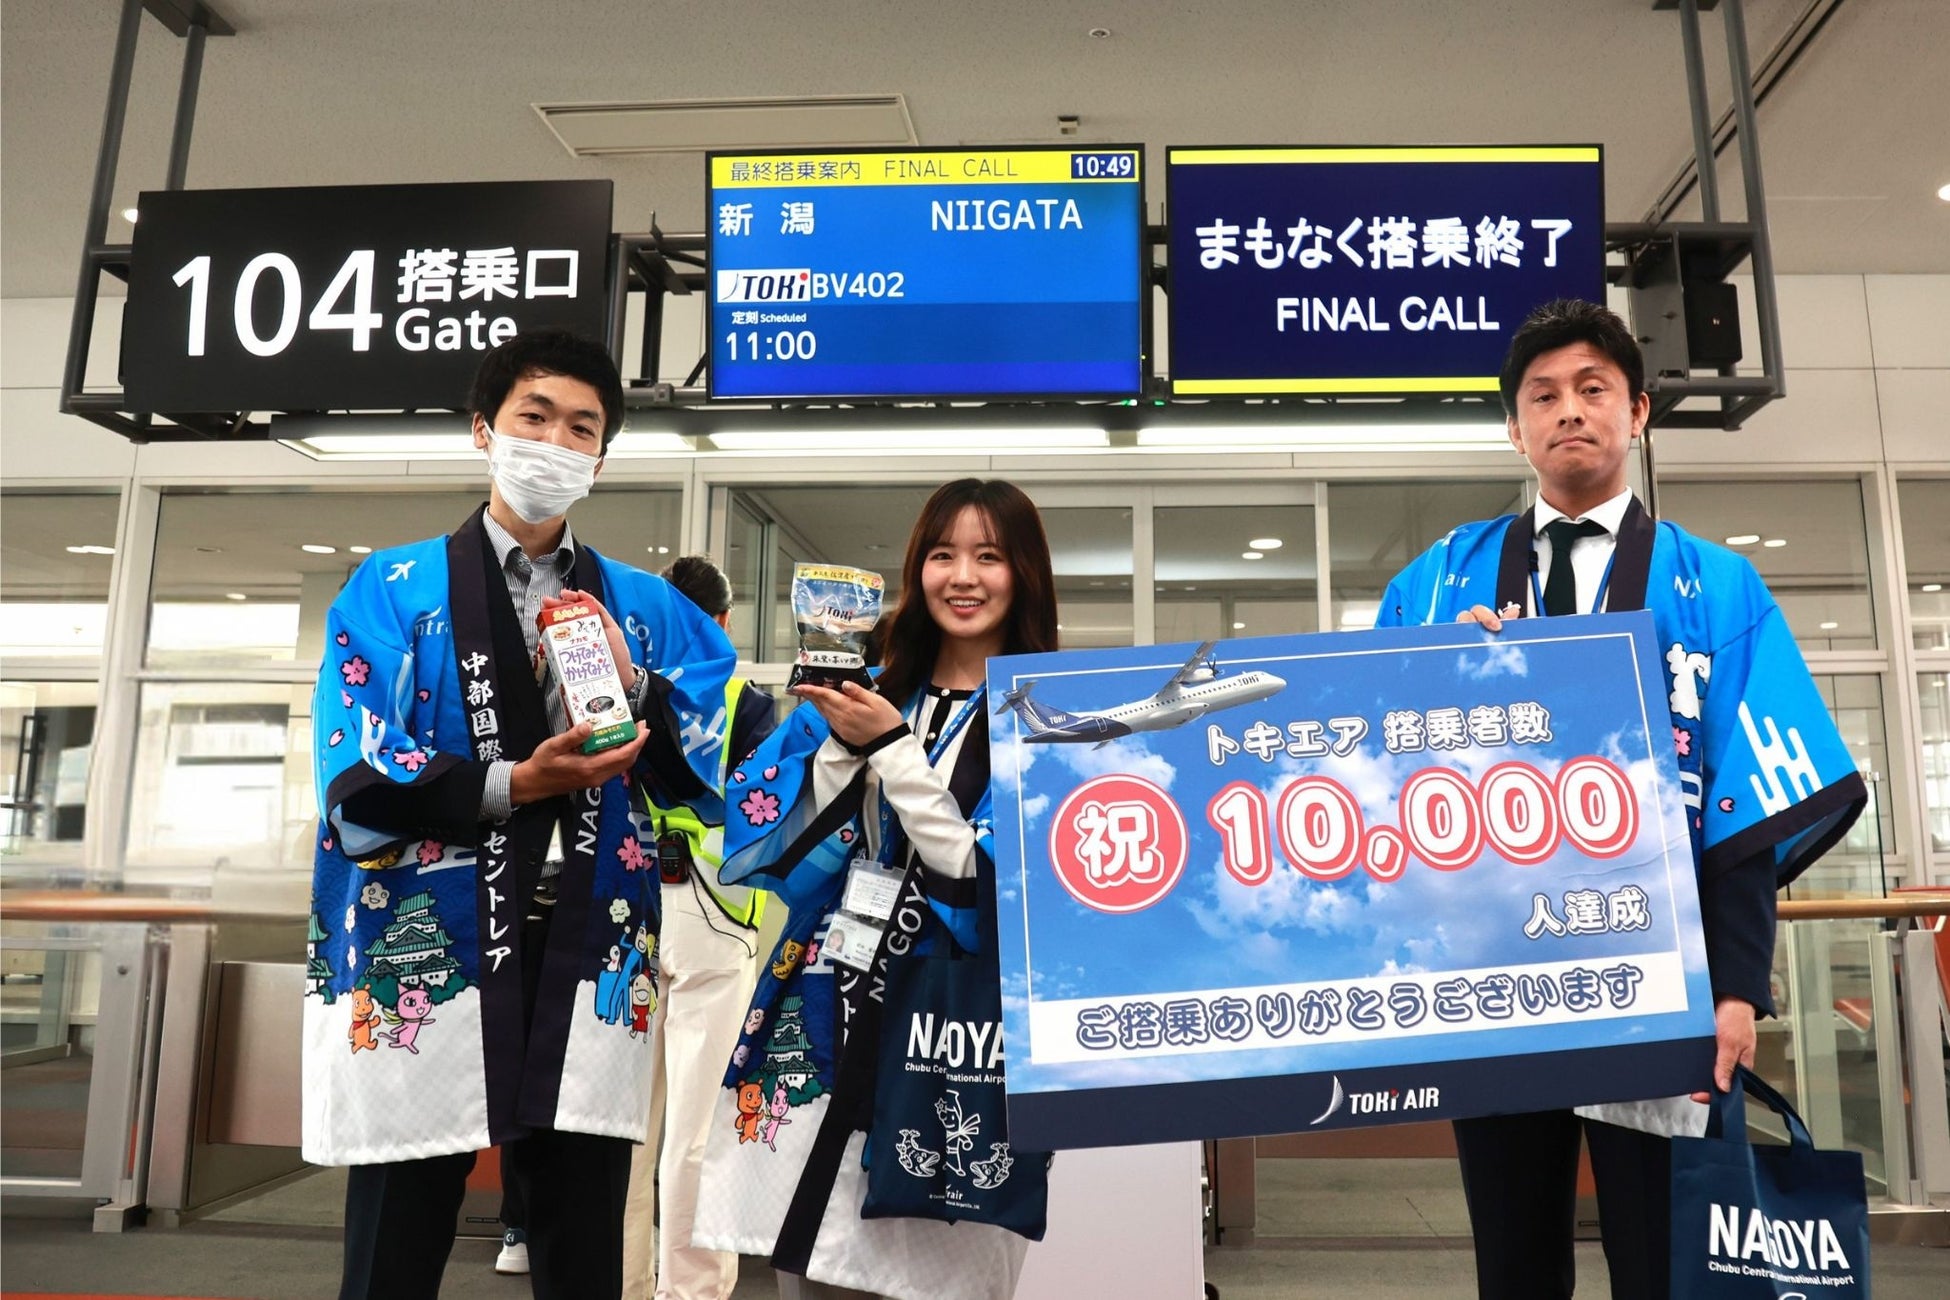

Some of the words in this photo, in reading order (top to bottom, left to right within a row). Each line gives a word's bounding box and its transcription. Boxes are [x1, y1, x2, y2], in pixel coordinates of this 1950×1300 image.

[730, 160, 862, 182] 最終搭乗案内
[884, 159, 950, 179] FINAL
[963, 158, 1019, 178] CALL
[1074, 154, 1132, 178] 10:49
[930, 198, 1084, 232] NIIGATA
[1195, 214, 1574, 270] まもなく搭乗終了
[396, 246, 580, 303] 搭乗口
[812, 271, 905, 299] BV402
[171, 249, 384, 357] 104
[731, 310, 759, 325] 定刻
[760, 311, 807, 324] Scheduled
[1276, 296, 1390, 332] FINAL
[1399, 295, 1500, 331] CALL
[395, 308, 518, 352] Gate
[725, 330, 817, 361] 11:00
[1205, 713, 1369, 766] トキエア
[1384, 700, 1553, 754] 搭乗者数
[1073, 798, 1166, 891] 祝
[1207, 755, 1640, 887] 10,000
[483, 831, 512, 973] セントレア
[1522, 885, 1652, 941] 人達成
[1076, 962, 1645, 1051] ご搭乗ありがとうございます
[906, 1012, 1005, 1069] NAOYA
[904, 1062, 932, 1073] Chubu
[1402, 1086, 1440, 1111] AIR
[1708, 1202, 1851, 1271] NAGOYA
[1707, 1260, 1741, 1275] Chubu
[1821, 1275, 1854, 1288] Airport
